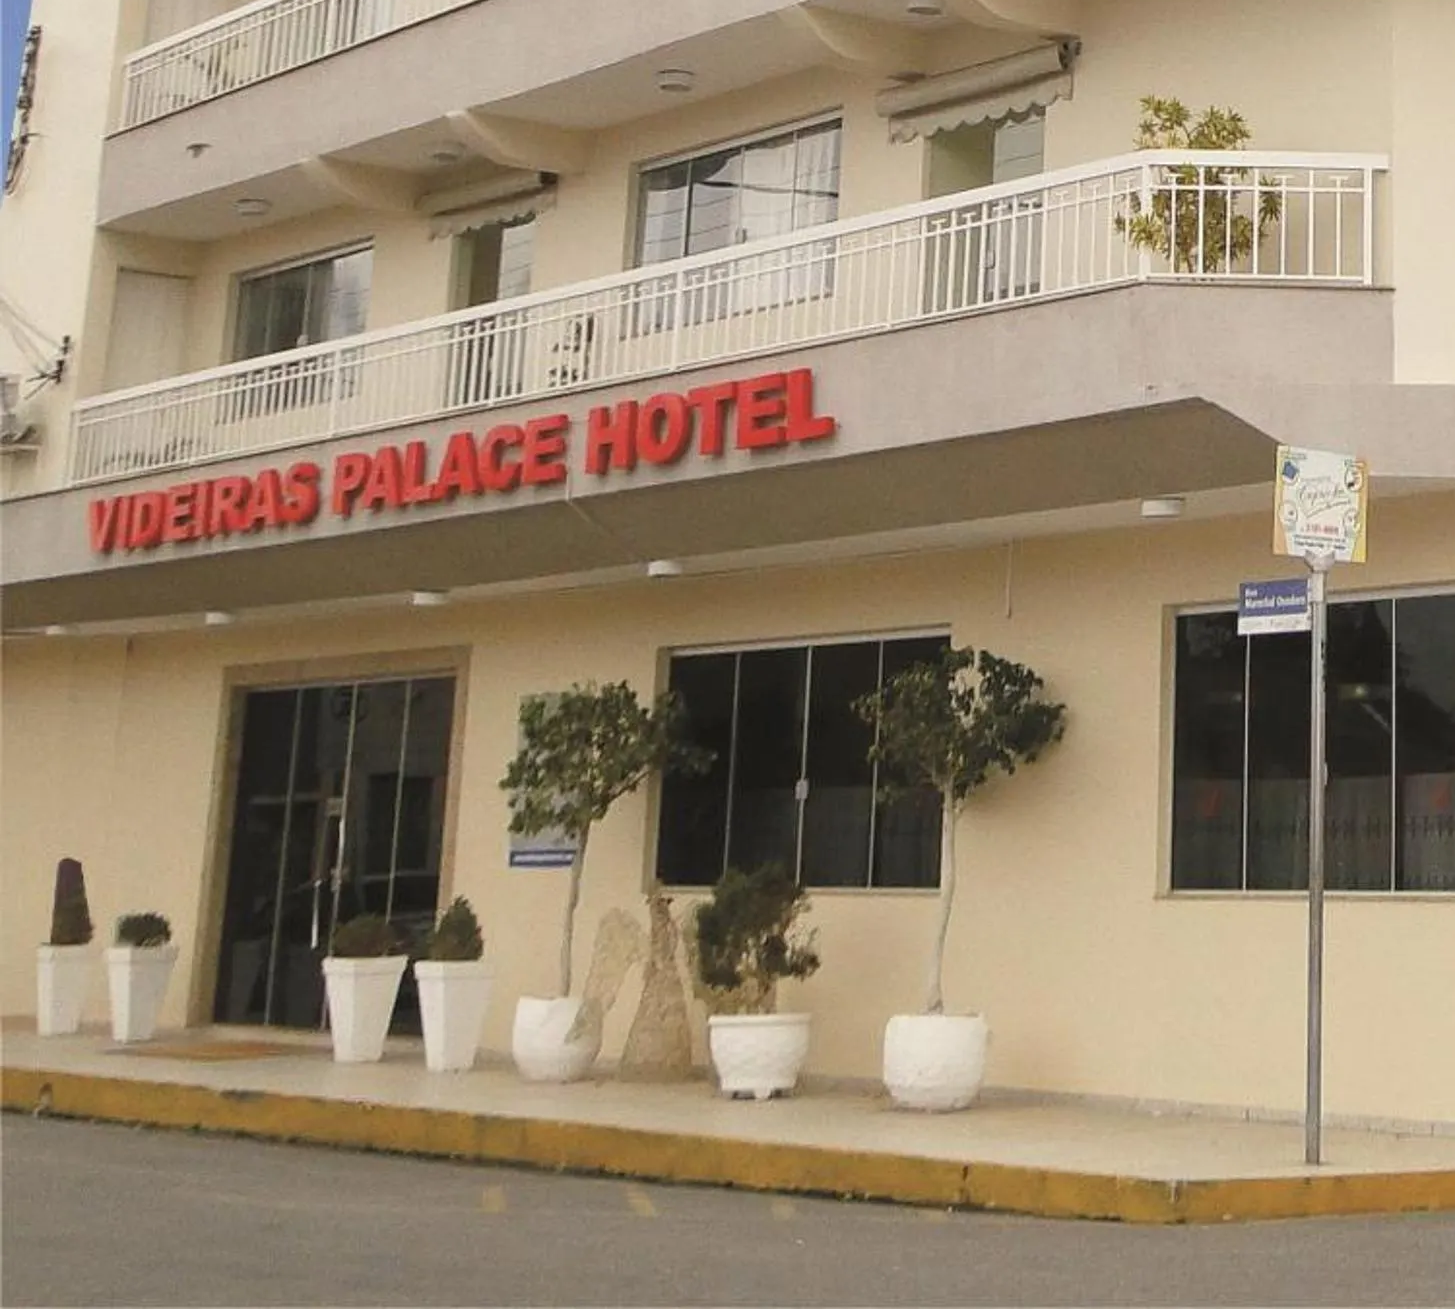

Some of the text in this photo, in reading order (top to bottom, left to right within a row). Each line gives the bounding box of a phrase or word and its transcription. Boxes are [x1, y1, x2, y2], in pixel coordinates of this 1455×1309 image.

[88, 367, 837, 554] VIDEIRAS PALACE HOTEL
